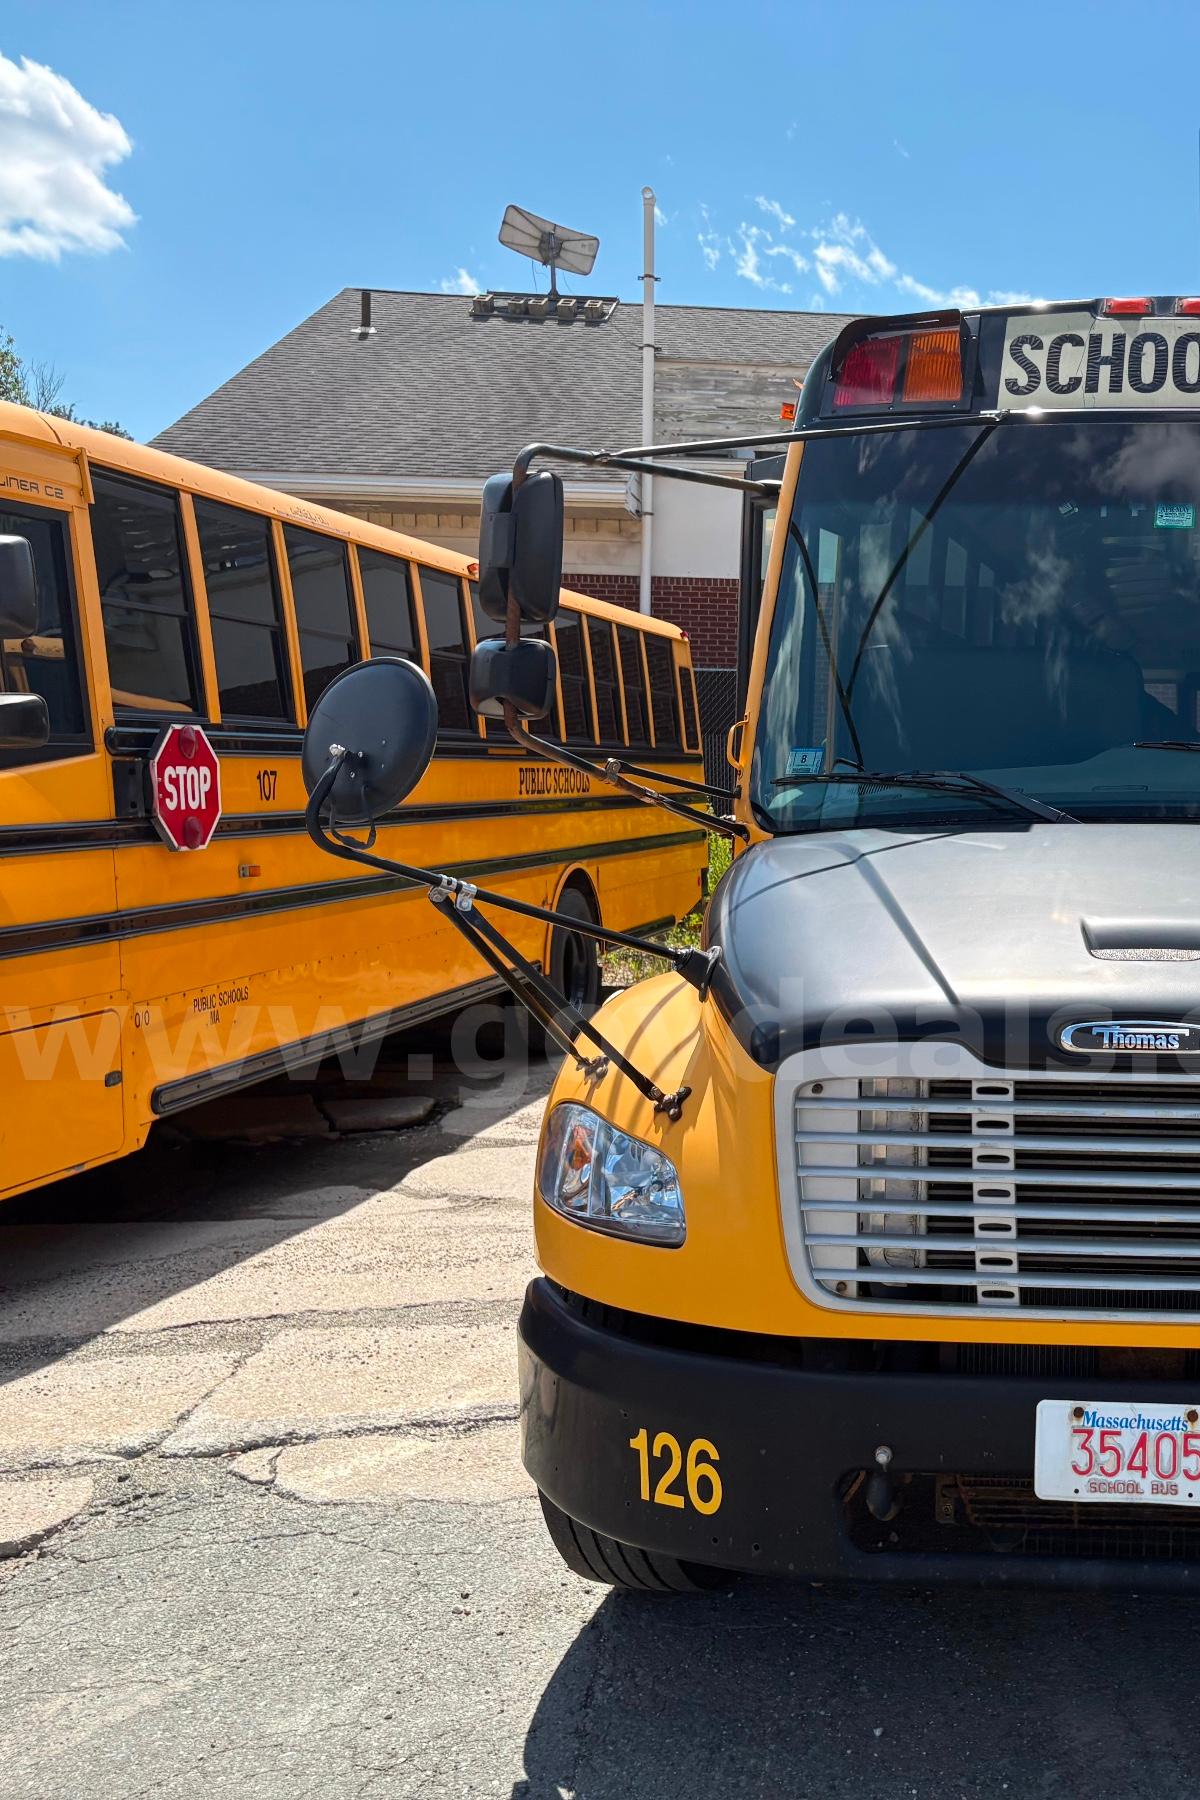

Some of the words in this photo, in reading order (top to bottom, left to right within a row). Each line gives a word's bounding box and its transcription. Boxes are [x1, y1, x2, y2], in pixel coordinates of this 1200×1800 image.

[45, 485, 64, 499] C2
[164, 765, 212, 811] STOP
[257, 769, 277, 801] 107
[519, 767, 551, 795] PUBLIC
[553, 767, 590, 794] SCHOOLS
[193, 994, 216, 1013] PUBLIC
[218, 986, 249, 1007] SCHOOLS
[210, 1010, 220, 1025] MA
[1092, 1025, 1190, 1049] Thomas
[1082, 1410, 1189, 1431] Massachusetts
[630, 1428, 723, 1515] 126
[1089, 1481, 1144, 1494] SCHOOL
[1151, 1483, 1178, 1496] BUS
